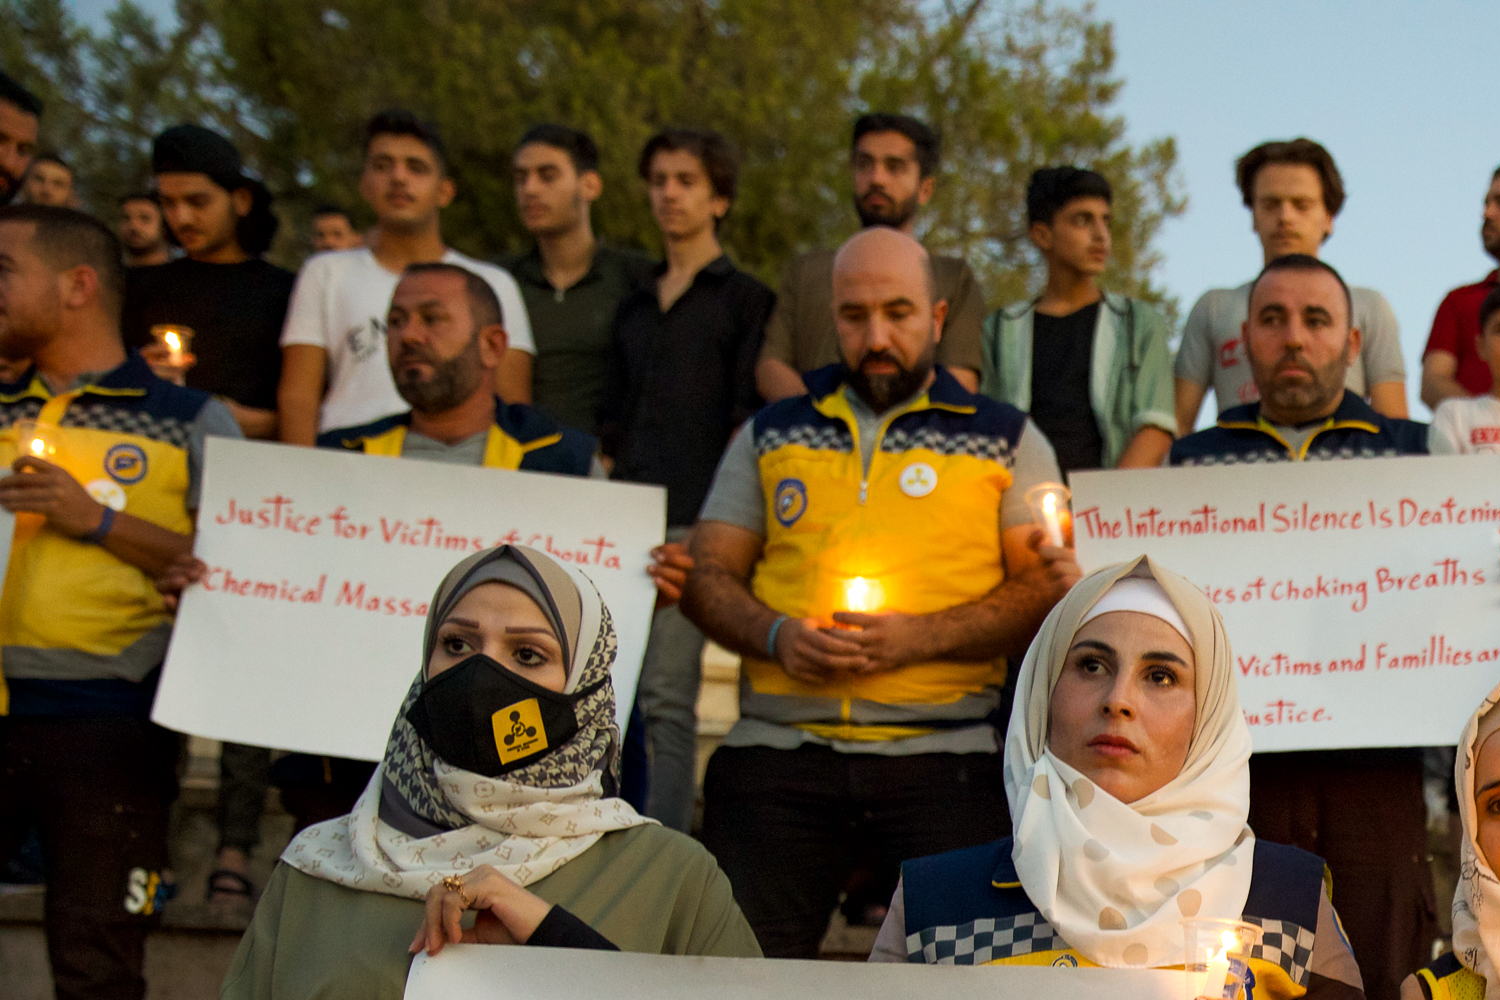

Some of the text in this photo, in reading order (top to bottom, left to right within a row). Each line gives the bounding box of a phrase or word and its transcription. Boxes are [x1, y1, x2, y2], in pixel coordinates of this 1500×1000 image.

[216, 495, 321, 536] Justice
[329, 506, 369, 539] for
[380, 518, 483, 551] Victims
[1076, 506, 1122, 539] The
[1125, 503, 1265, 538] International
[1272, 502, 1362, 533] Silence
[1369, 501, 1393, 527] Is
[204, 562, 428, 616] Chemical Massa
[1376, 558, 1485, 592] Breaths
[1237, 653, 1322, 676] Victims
[1328, 644, 1366, 672] and
